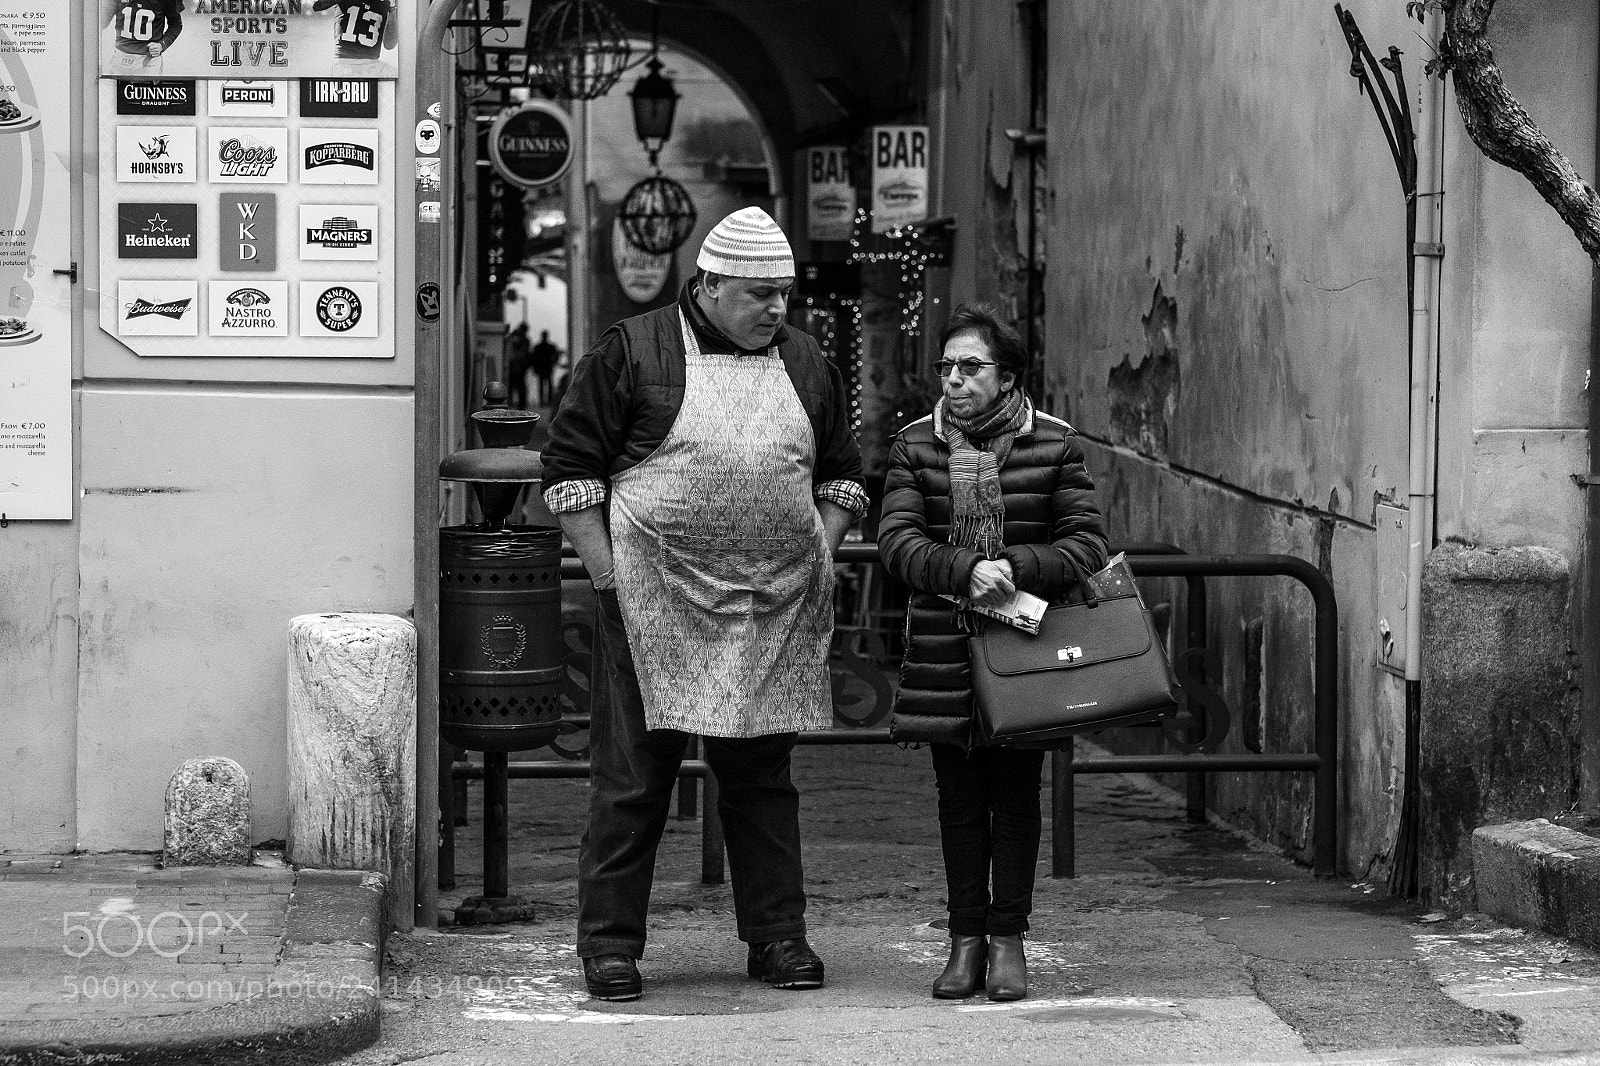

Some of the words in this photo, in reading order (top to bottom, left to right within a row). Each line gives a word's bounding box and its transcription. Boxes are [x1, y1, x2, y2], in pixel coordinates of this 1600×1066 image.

[195, 0, 302, 15] AMERICAN
[120, 6, 156, 41] 10
[210, 17, 288, 34] SPORTS
[341, 5, 383, 48] 13
[210, 40, 289, 67] LIVE
[124, 84, 188, 102] GUINNESS
[224, 89, 272, 101] PERONI
[219, 138, 278, 164] Coors
[309, 147, 370, 165] KOPPARBERG
[877, 131, 926, 168] BAR
[130, 162, 184, 174] HORNSBY'S
[219, 162, 275, 177] LIGHT
[125, 233, 191, 248] Heineken
[311, 229, 369, 242] MAGNERS
[319, 289, 359, 308] TENNENT'S
[125, 301, 192, 315] Budweiser
[226, 307, 272, 318] NASTRO
[221, 317, 276, 328] AZZURRO
[324, 318, 354, 330] SUPER
